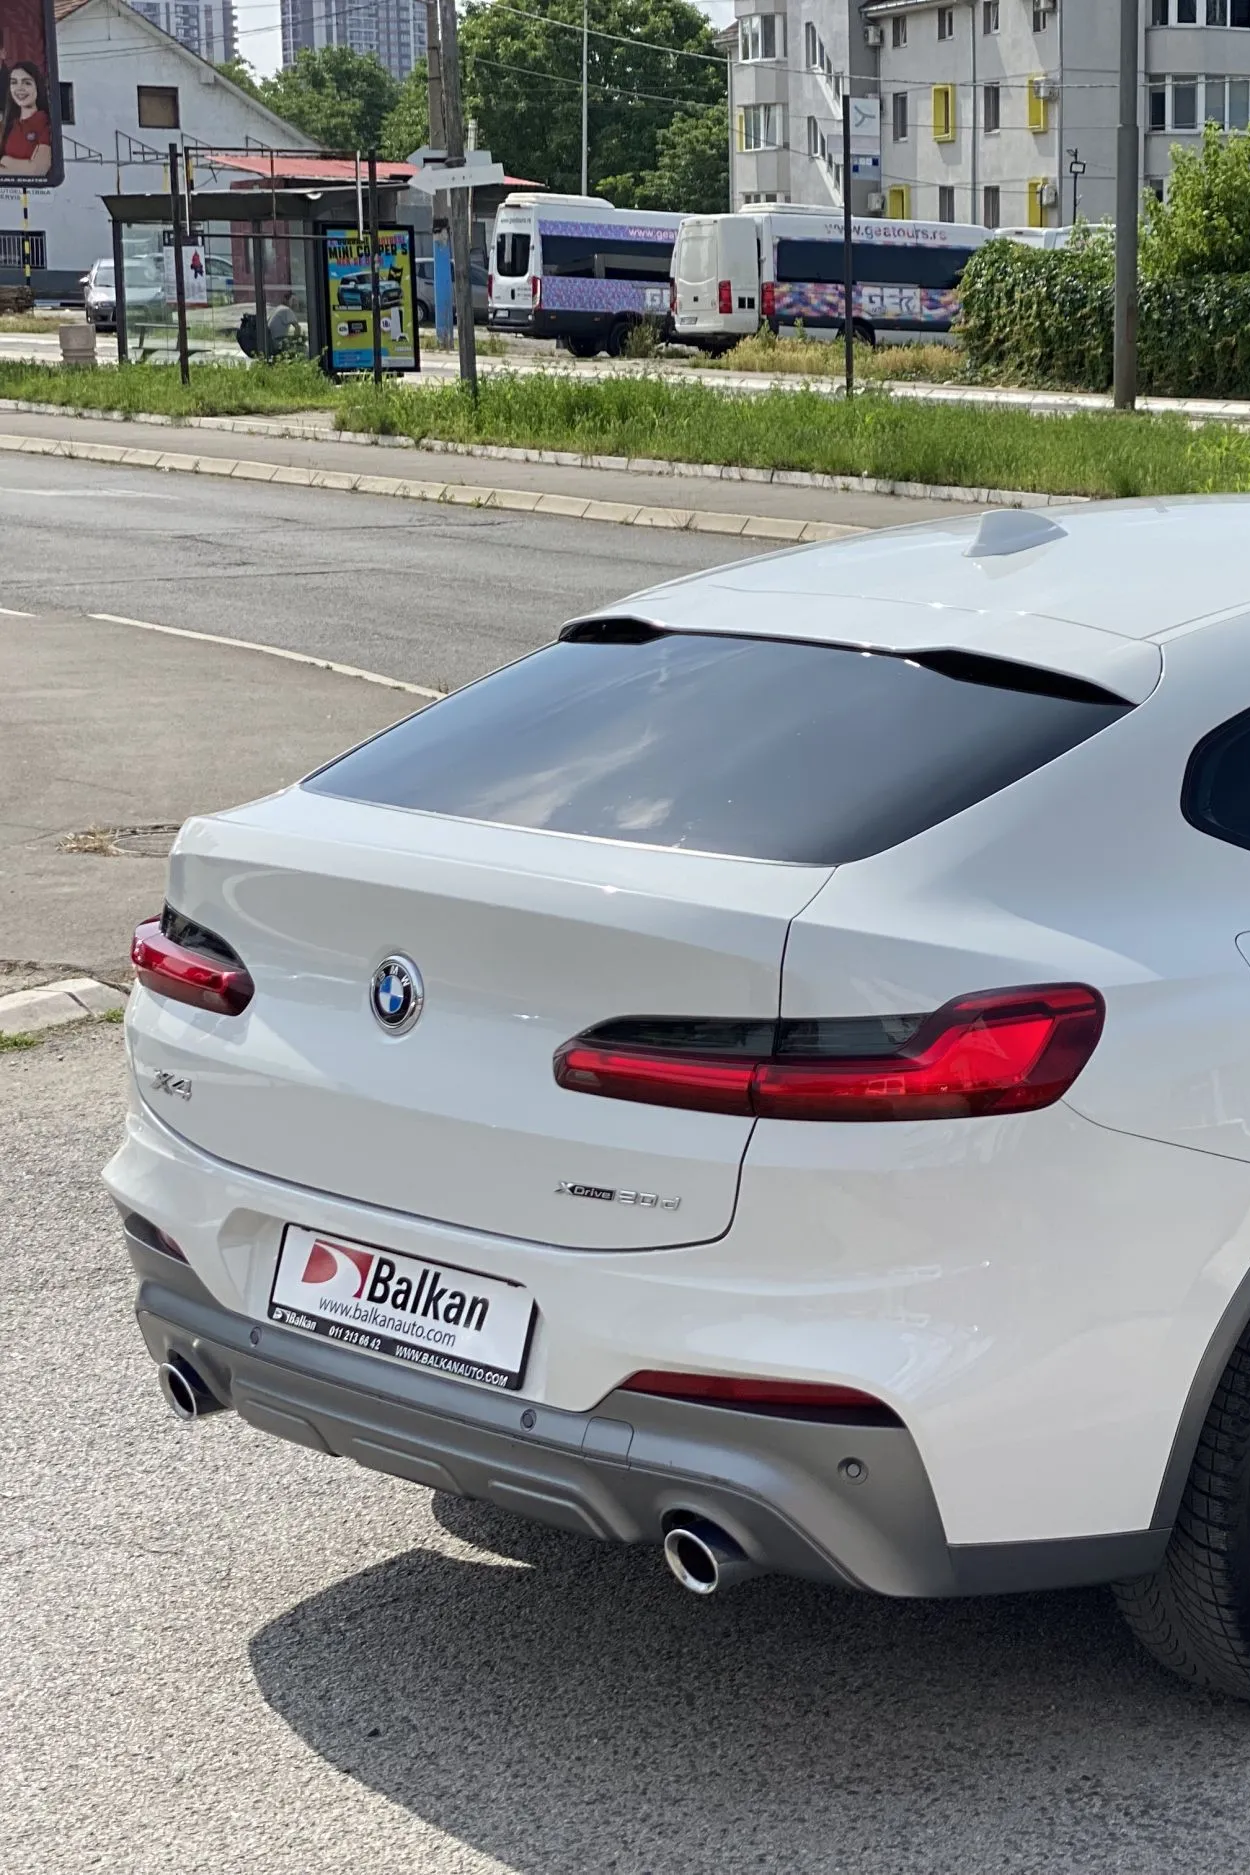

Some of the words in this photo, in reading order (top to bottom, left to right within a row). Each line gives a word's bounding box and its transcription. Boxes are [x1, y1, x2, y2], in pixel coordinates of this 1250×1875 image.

[328, 247, 353, 260] MINI
[356, 243, 397, 257] COPER
[379, 964, 411, 987] BMW
[151, 1068, 192, 1101] X4
[367, 1257, 490, 1332] Balkan
[319, 1297, 456, 1348] www.balkanauto.com
[288, 1311, 317, 1331] Balkan
[329, 1325, 343, 1339] 011
[343, 1330, 359, 1343] 213
[370, 1338, 381, 1350] 42
[395, 1345, 509, 1388] WWW.BALKANAUTO.COM
